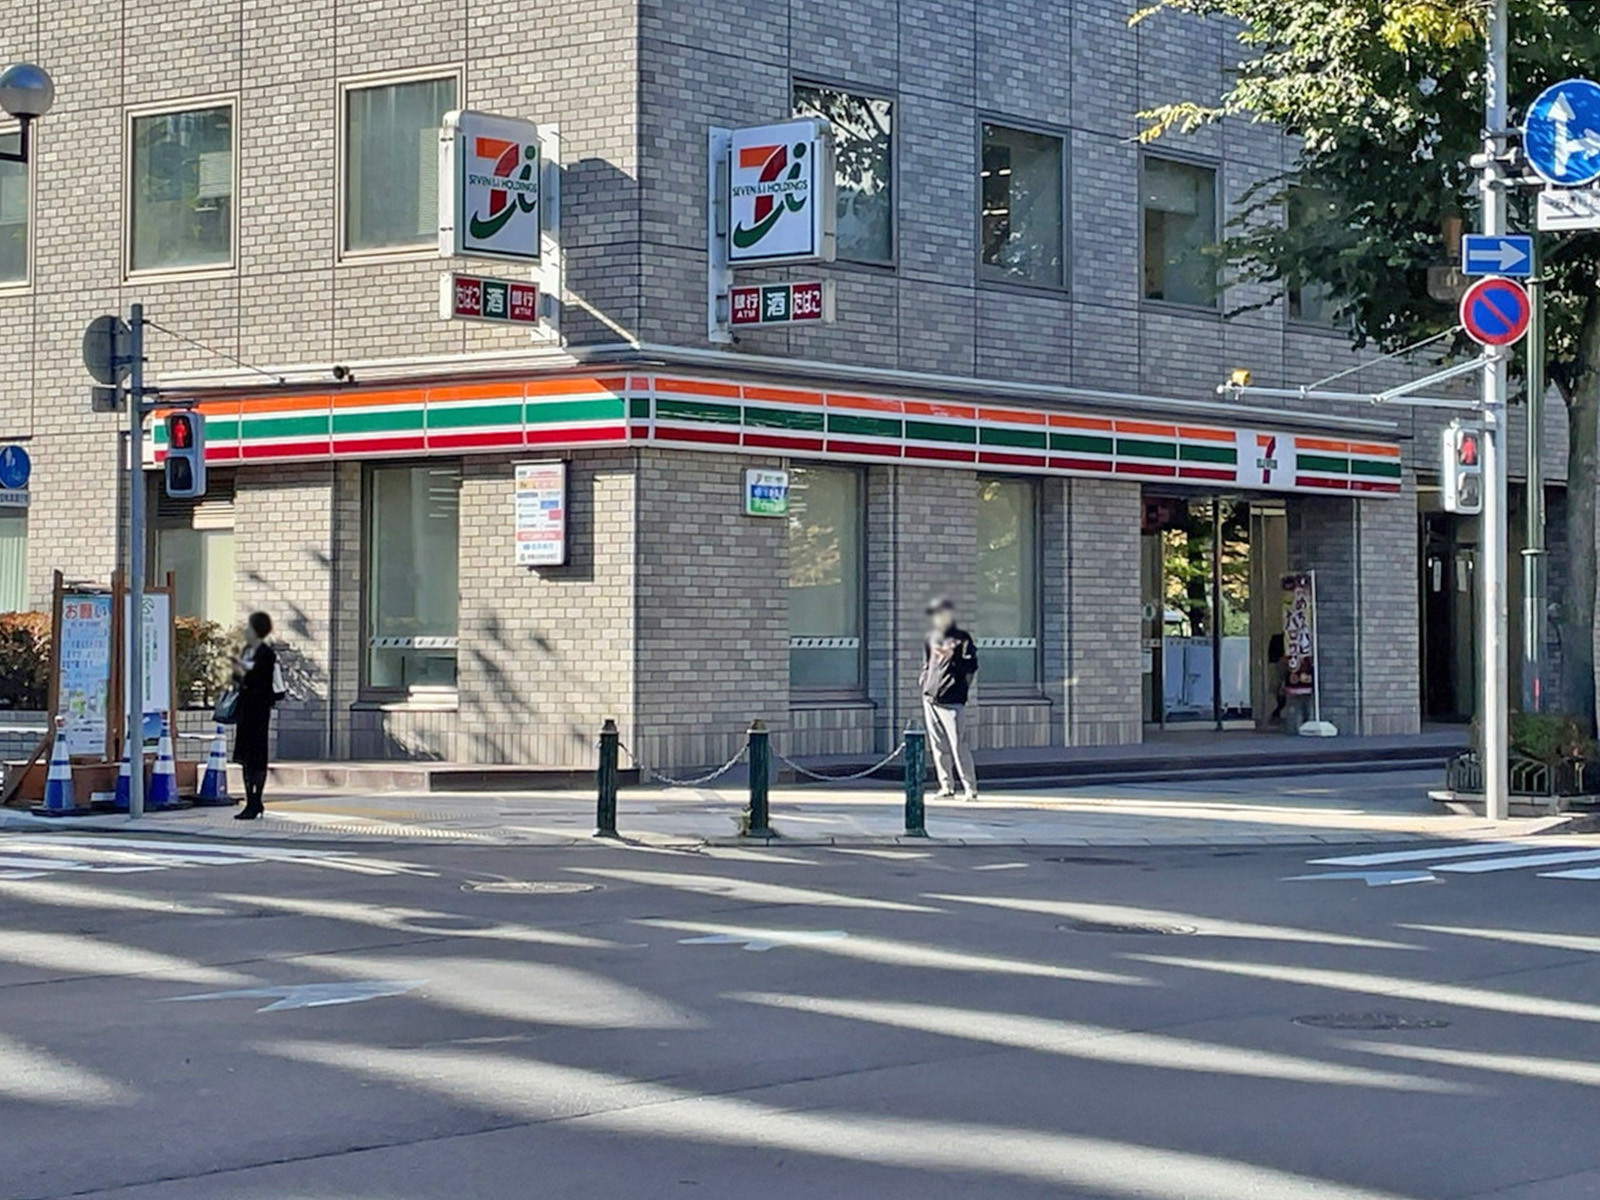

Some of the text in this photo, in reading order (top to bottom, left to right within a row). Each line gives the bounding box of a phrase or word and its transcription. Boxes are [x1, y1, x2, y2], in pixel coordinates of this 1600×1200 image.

[456, 284, 480, 310] たばこ
[486, 288, 504, 313] 酒
[734, 293, 758, 310] 銀行
[766, 292, 786, 317] 酒
[793, 289, 820, 315] たばこ
[736, 309, 756, 319] ATM
